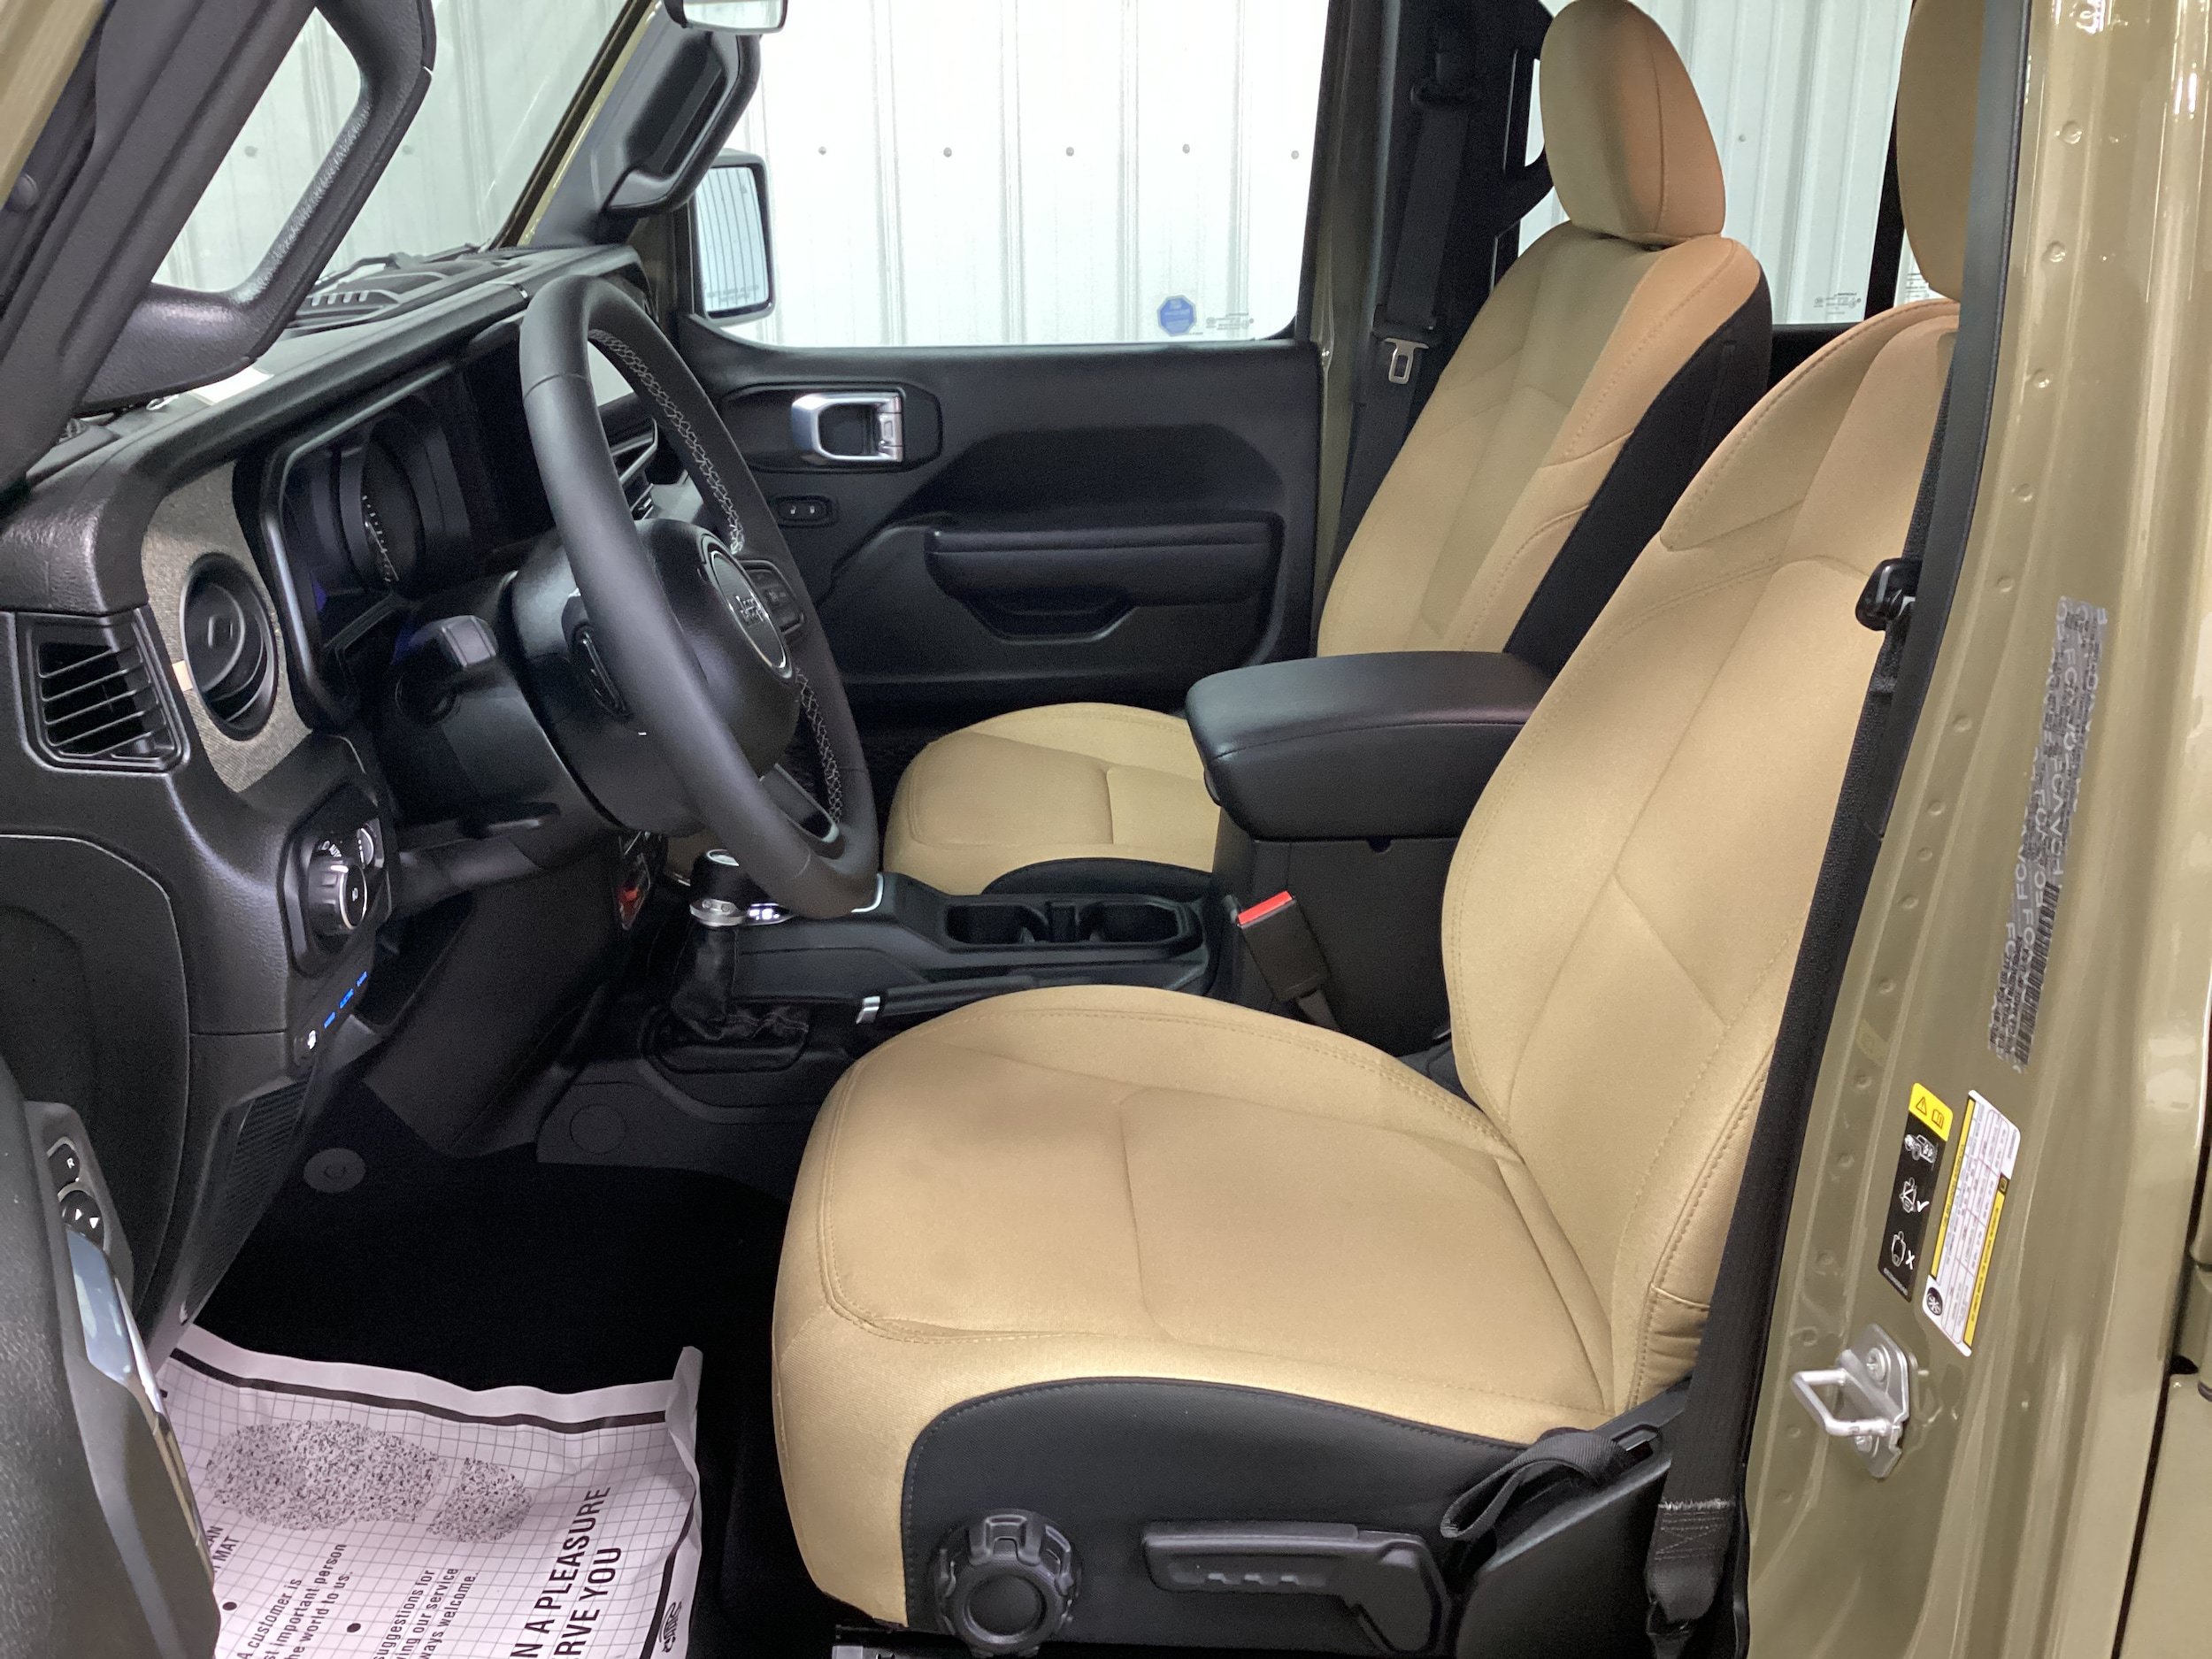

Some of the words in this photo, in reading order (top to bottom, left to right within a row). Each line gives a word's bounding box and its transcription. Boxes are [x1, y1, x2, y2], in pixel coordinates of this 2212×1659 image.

[66, 1157, 75, 1169] R
[212, 1536, 240, 1562] MAT
[534, 1487, 611, 1609] PLEASURE
[249, 1593, 292, 1649] customer
[284, 1578, 302, 1589] is
[270, 1588, 319, 1647] important
[314, 1543, 347, 1585] person
[299, 1608, 330, 1643] world
[321, 1593, 339, 1605] to
[334, 1571, 353, 1590] us.
[373, 1589, 424, 1659] suggestions
[415, 1570, 435, 1586] for
[412, 1613, 432, 1633] our
[426, 1568, 459, 1610] service
[438, 1572, 480, 1627] welcome.
[524, 1618, 555, 1635] A
[551, 1609, 601, 1659] RVE
[578, 1548, 621, 1601] YOU
